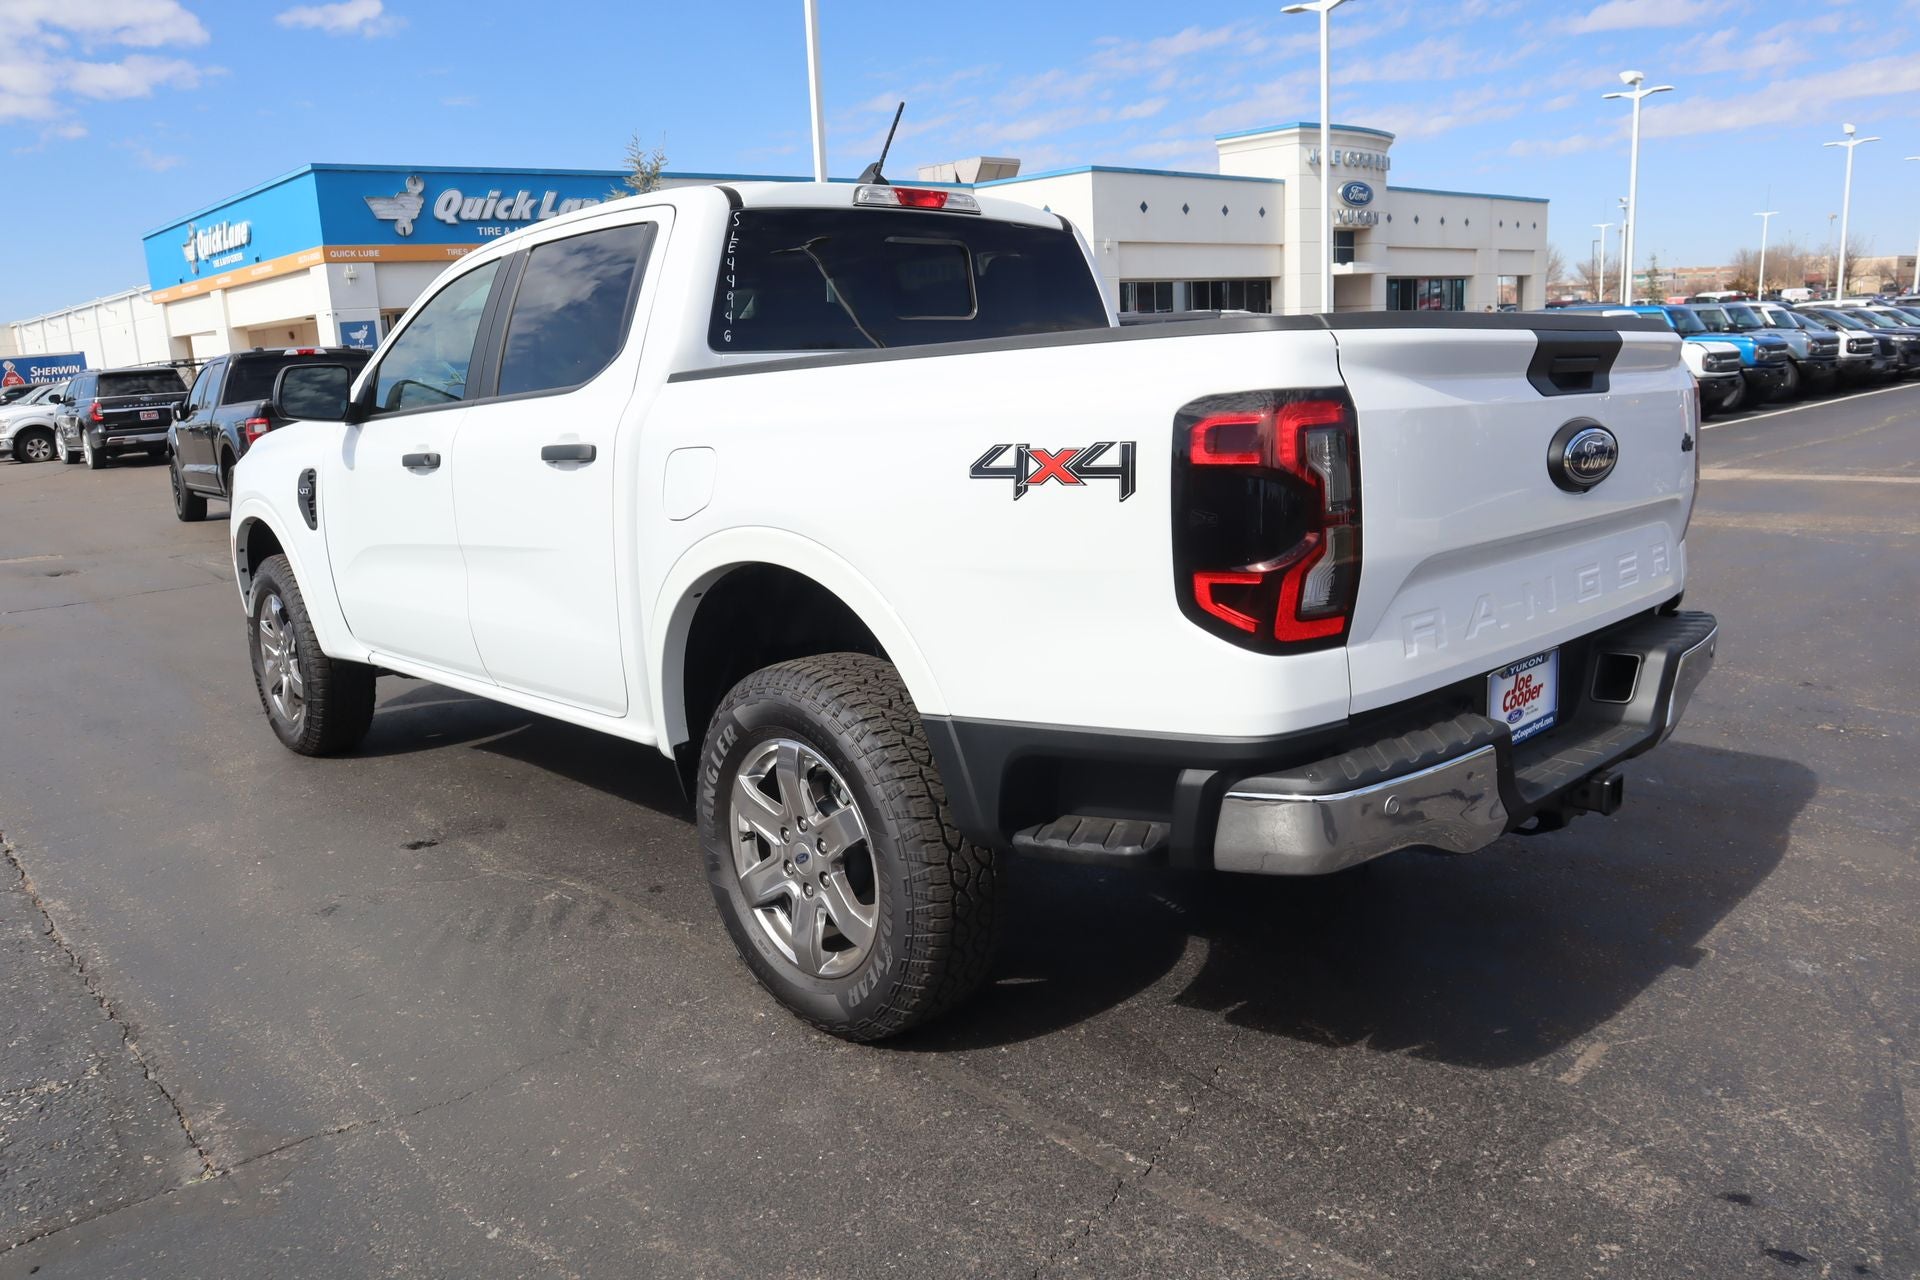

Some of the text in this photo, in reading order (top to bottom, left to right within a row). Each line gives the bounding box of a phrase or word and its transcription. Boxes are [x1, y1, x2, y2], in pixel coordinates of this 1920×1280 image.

[1349, 185, 1369, 201] Ford
[433, 188, 605, 225] Quick Lan
[1336, 209, 1379, 225] YUKON
[197, 224, 223, 262] Quick
[223, 220, 251, 248] Lane
[476, 226, 501, 236] TIRE
[330, 249, 356, 258] QUICK
[358, 249, 380, 257] LUBE
[30, 364, 80, 378] SHERWIN
[1401, 542, 1672, 659] RANGER
[1509, 655, 1543, 675] YUKON
[1511, 673, 1533, 696] Joe
[1502, 682, 1544, 713] Cooper
